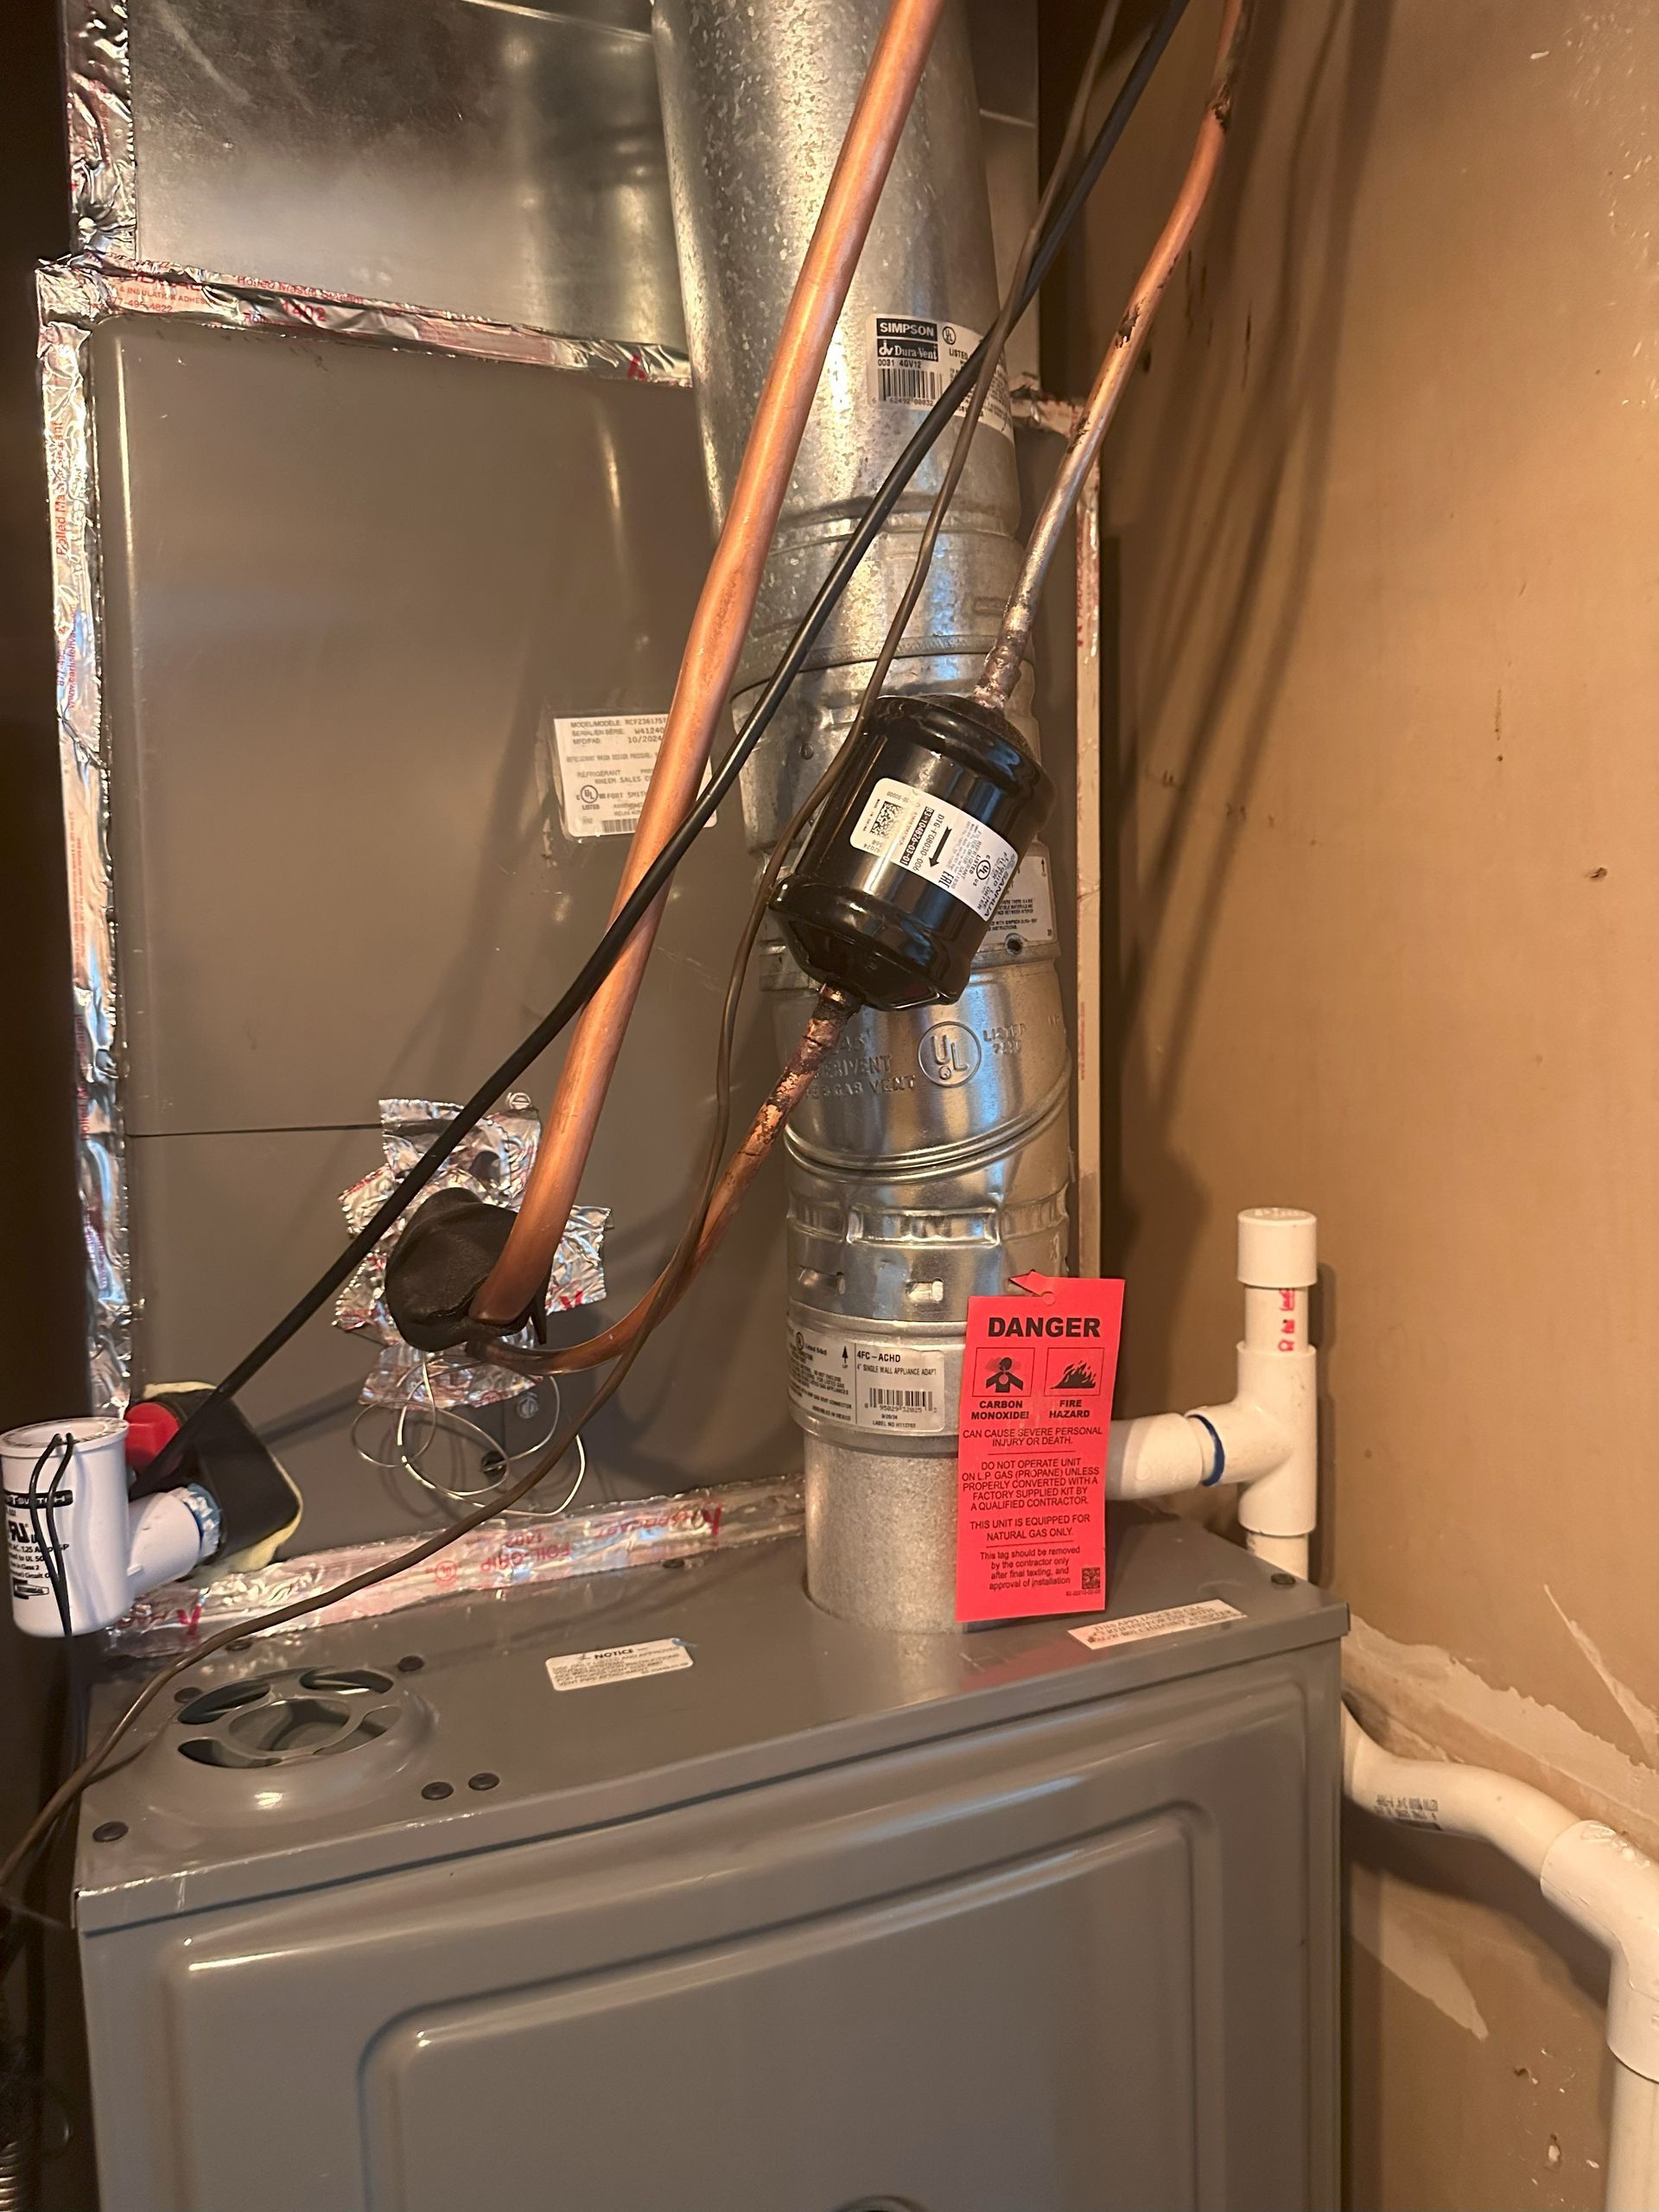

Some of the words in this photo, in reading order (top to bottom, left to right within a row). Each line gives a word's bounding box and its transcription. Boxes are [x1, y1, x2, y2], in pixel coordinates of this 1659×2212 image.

[879, 322, 933, 337] SIMPSON
[900, 807, 933, 865] 33-104826-03-01
[969, 855, 981, 874] LISTED
[983, 871, 1009, 918] SANHUA
[988, 1317, 1101, 1338] DANGER
[863, 1364, 878, 1373] SINGLE
[979, 1401, 1023, 1409] CARBON
[971, 1411, 1029, 1420] MONOXIDE!
[963, 1430, 982, 1439] CAN
[984, 1429, 1015, 1438] CAUSE
[1018, 1428, 1053, 1437] SEVERE
[1056, 1427, 1103, 1436] PERSONAL
[993, 1438, 1024, 1446] INJURY
[1041, 1437, 1073, 1446] DEATH.
[997, 1460, 1015, 1469] NOT
[1018, 1459, 1058, 1468] OPERATE
[1015, 1470, 1063, 1480] (PROPANE)
[1065, 1467, 1099, 1476] UNLESS
[963, 1481, 1009, 1491] PROPERLY
[1012, 1478, 1066, 1489] CONVERTED
[973, 1491, 1014, 1500] FACTORY
[1015, 1488, 1058, 1497] SUPPLIED
[1061, 1487, 1074, 1496] KIT
[970, 1503, 977, 1511] A
[978, 1500, 1025, 1510] QUALIFIED
[1027, 1497, 1089, 1508] CONTRACTOR.
[969, 1520, 989, 1529] THIS
[992, 1519, 1013, 1529] UNIT
[1025, 1515, 1071, 1527] EQUIPPED
[1072, 1514, 1090, 1523] FOR
[987, 1531, 1027, 1541] NATURAL
[1028, 1529, 1047, 1538] GAS
[998, 1551, 1009, 1560] tag
[1011, 1549, 1036, 1559] should
[1048, 1546, 1080, 1555] removed
[991, 1561, 1000, 1571] by
[1015, 1558, 1052, 1568] contractor
[1054, 1557, 1069, 1567] only
[1009, 1570, 1025, 1579] final
[1055, 1567, 1070, 1575] and
[989, 1580, 1020, 1591] approval
[1023, 1579, 1030, 1587] of
[1032, 1577, 1071, 1587] installation
[594, 1649, 634, 1660] NOTICE
